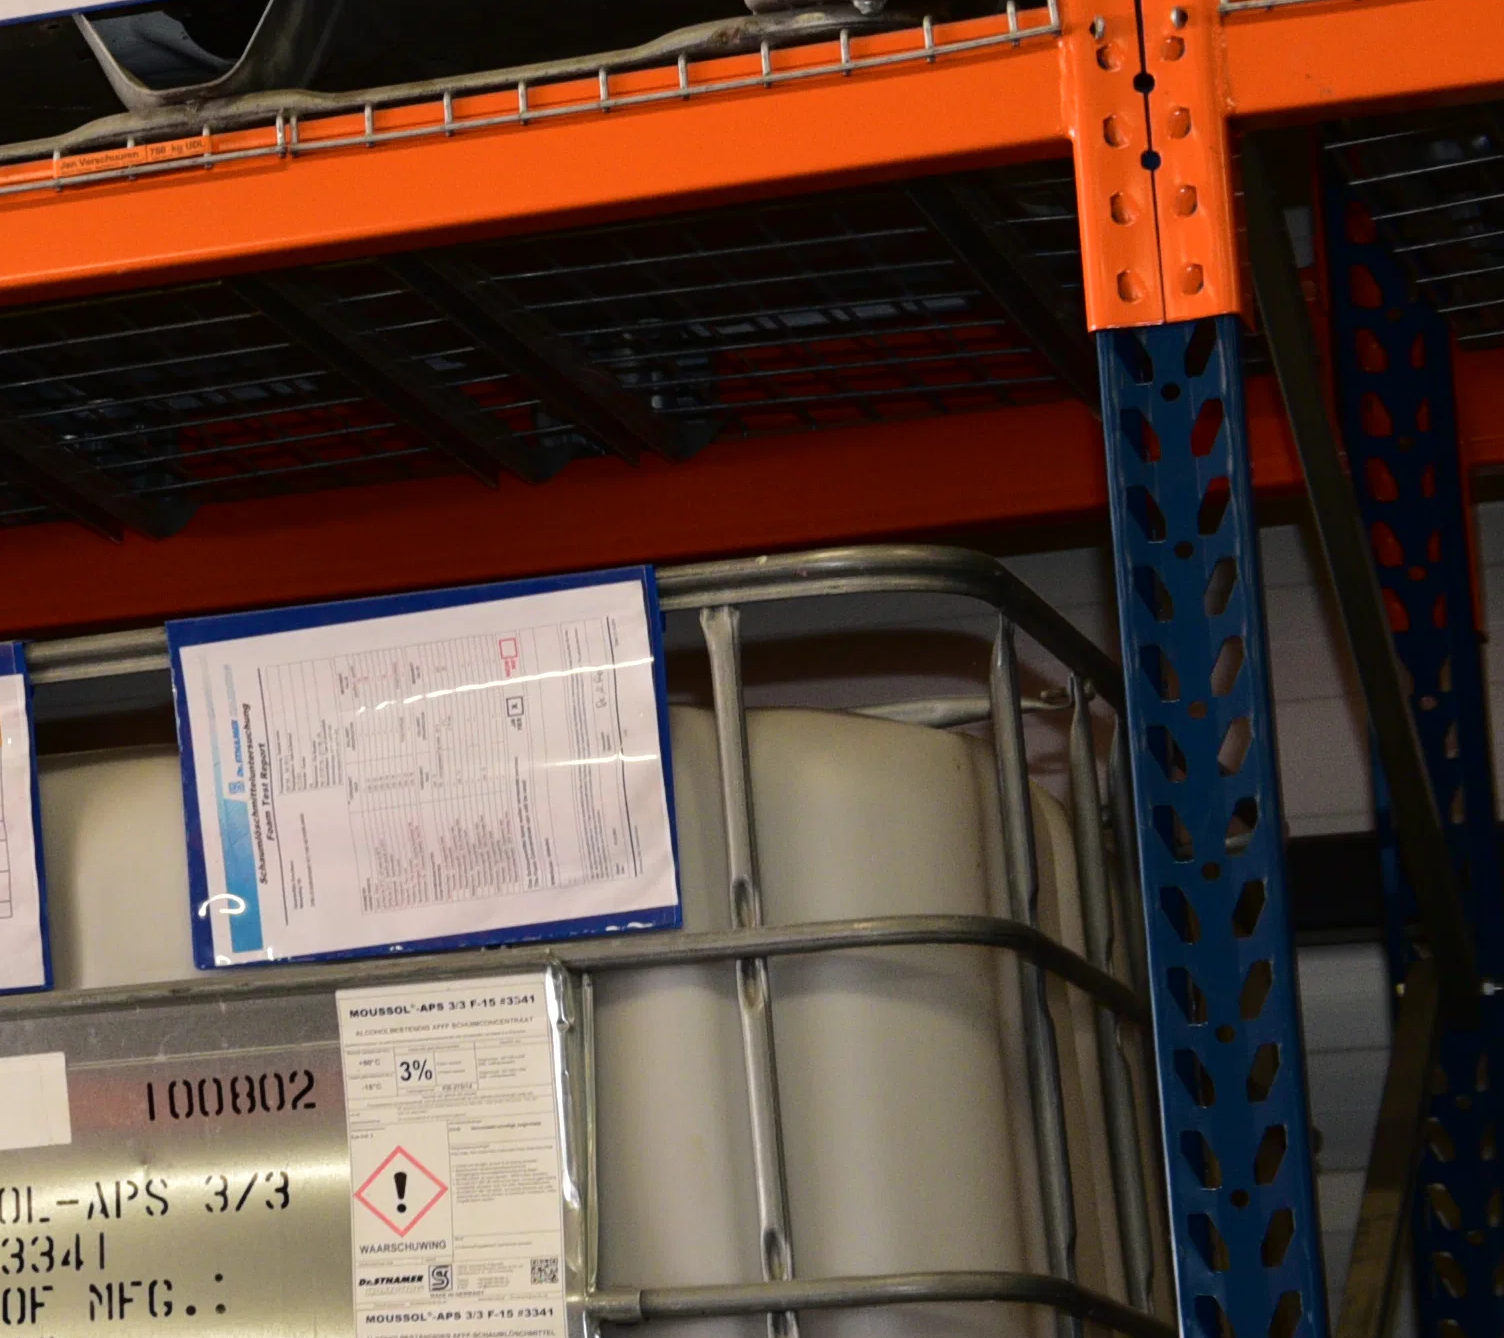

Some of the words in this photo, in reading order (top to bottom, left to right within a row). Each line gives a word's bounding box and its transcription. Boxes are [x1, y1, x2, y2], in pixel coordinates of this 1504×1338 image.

[257, 742, 271, 781] Report
[261, 782, 271, 807] Test
[264, 811, 276, 842] Foam
[470, 998, 496, 1009] F-15
[399, 1059, 433, 1082] 3%
[146, 1070, 317, 1122] 100802
[204, 1170, 290, 1214] 3/3
[1, 1233, 106, 1276] 3341
[359, 1240, 446, 1254] WAARSCHUWING
[2, 1283, 53, 1326] OF
